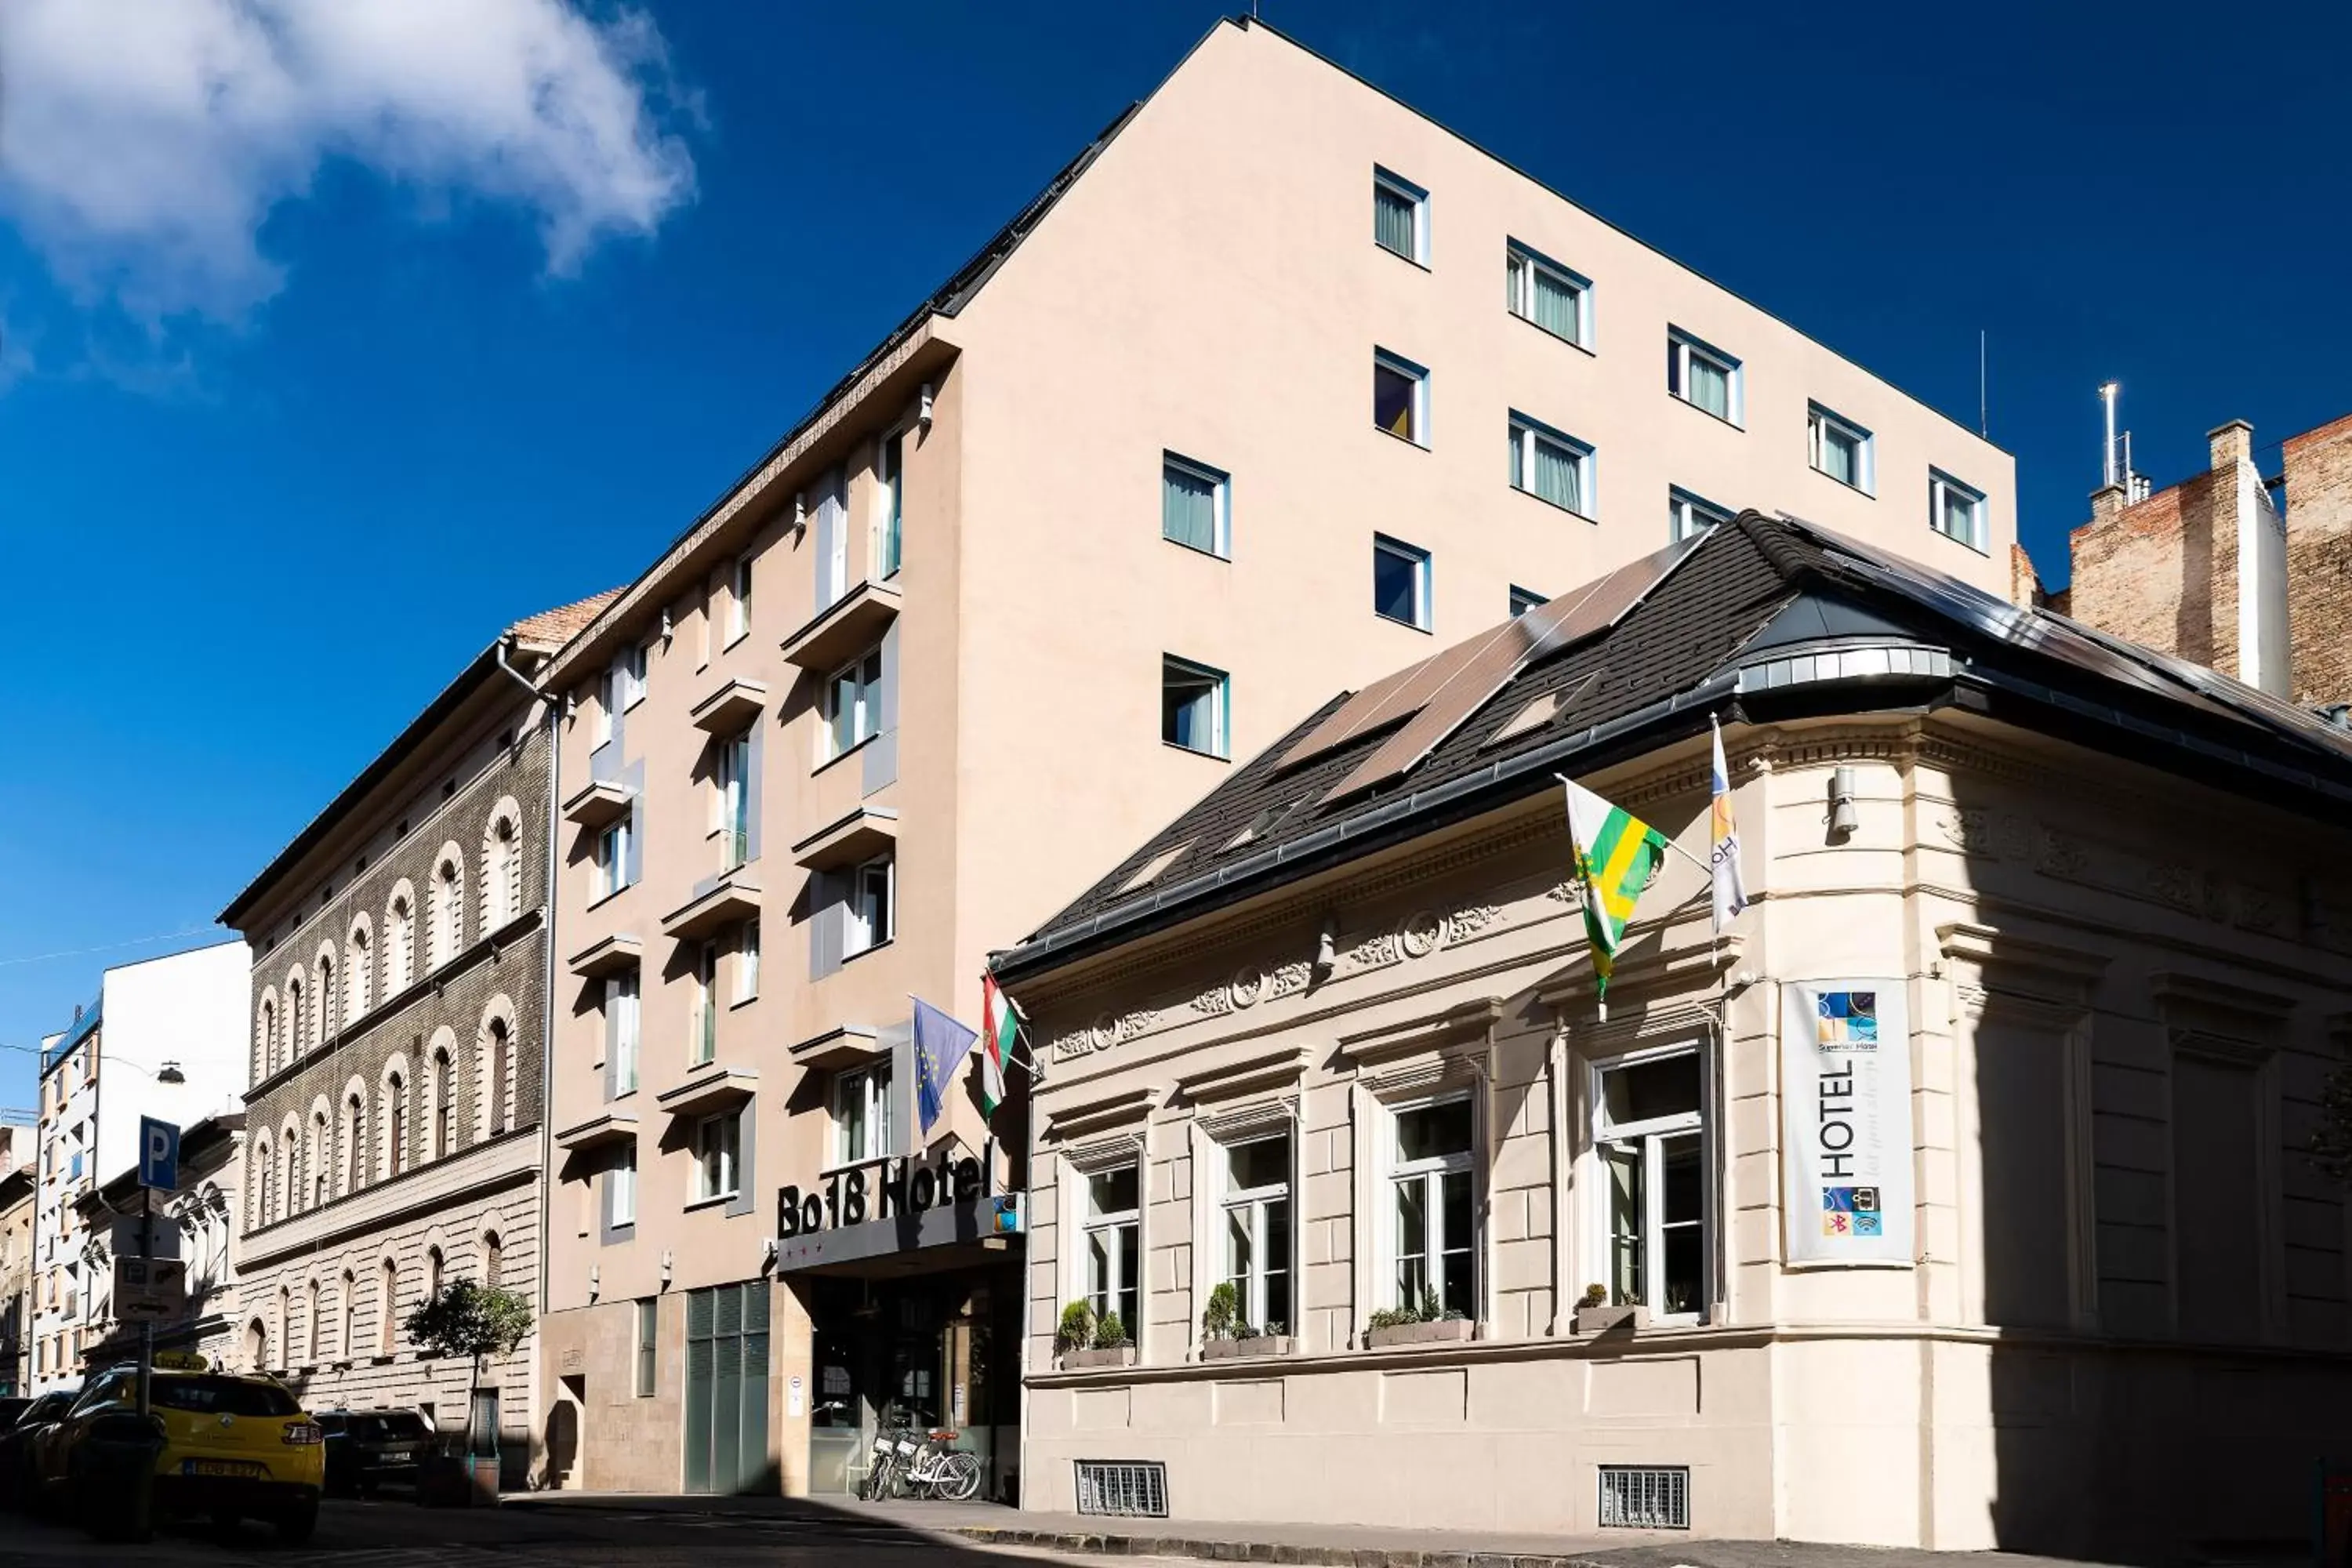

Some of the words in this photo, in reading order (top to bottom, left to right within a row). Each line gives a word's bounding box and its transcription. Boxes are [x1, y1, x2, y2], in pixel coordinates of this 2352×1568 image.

[148, 1125, 170, 1181] P
[1820, 1060, 1853, 1177] HOTEL
[778, 1168, 866, 1239] Bo18
[880, 1137, 993, 1218] Hotel
